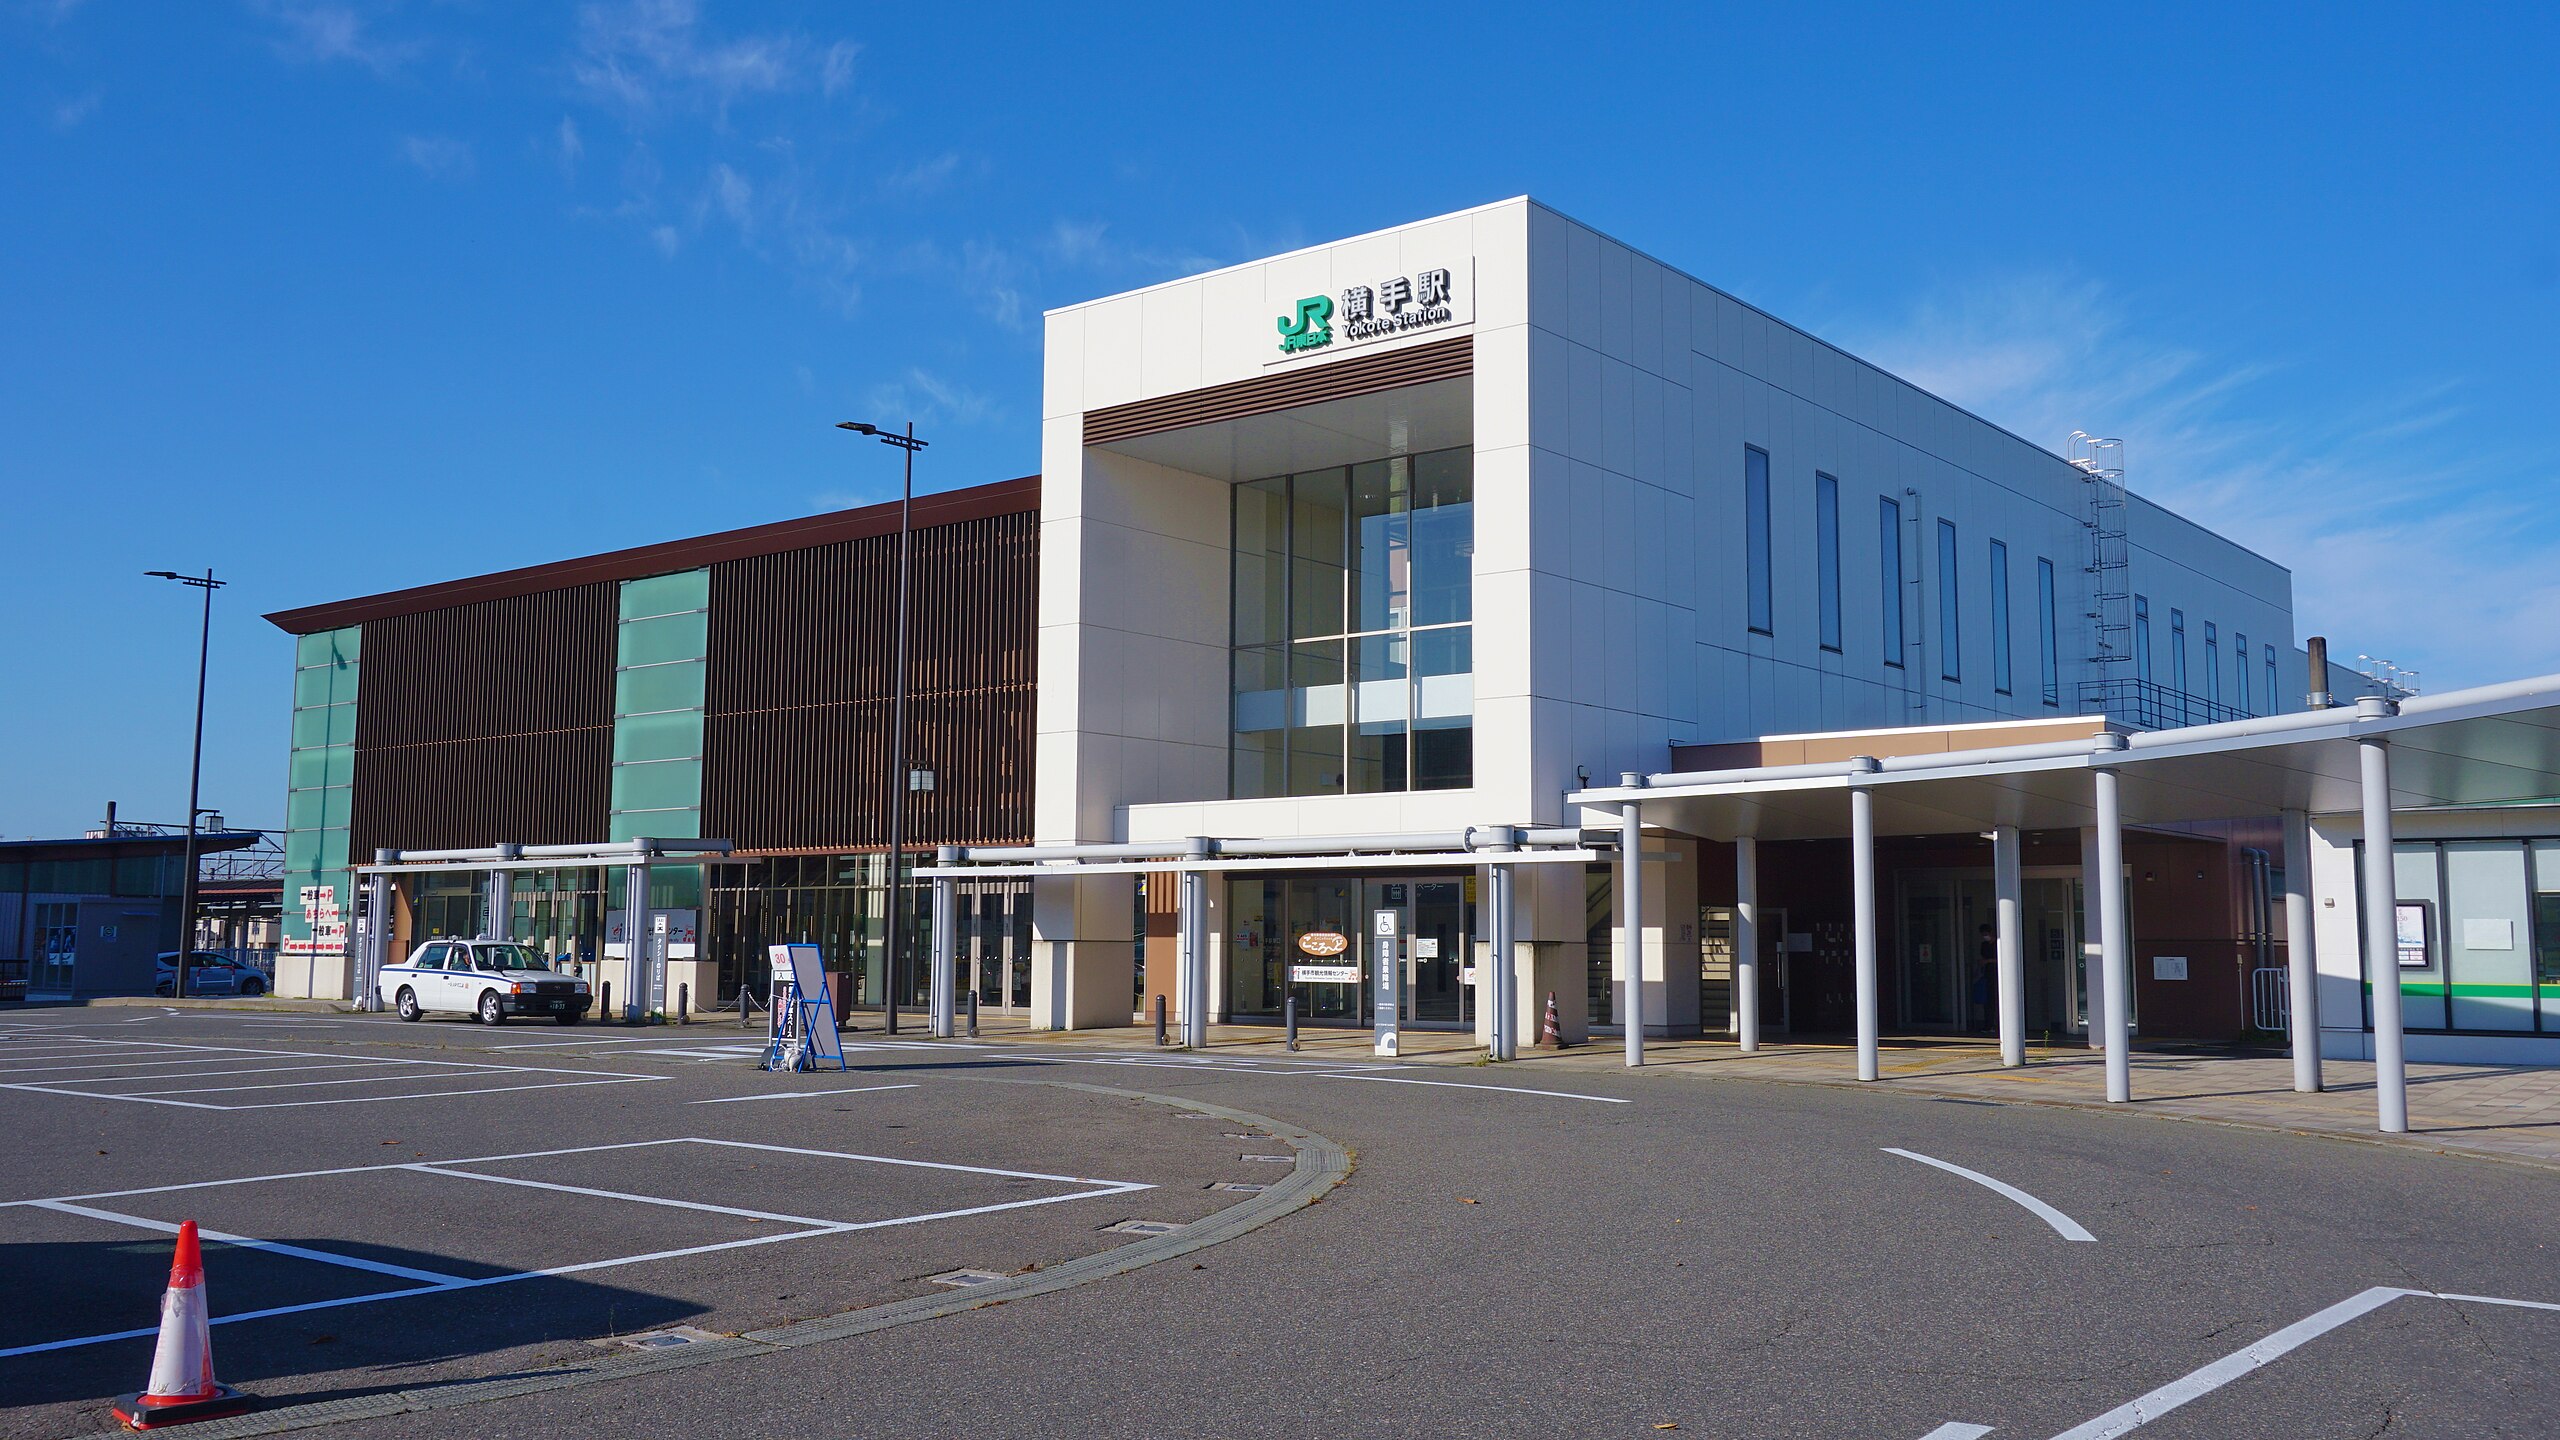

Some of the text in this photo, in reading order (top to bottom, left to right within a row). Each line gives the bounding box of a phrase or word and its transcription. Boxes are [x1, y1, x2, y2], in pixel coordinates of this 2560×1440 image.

[1341, 268, 1449, 321] 横手駅
[1278, 295, 1333, 335] JR
[1342, 307, 1449, 338] Yokote Station
[1279, 330, 1331, 351] JR東日本
[301, 889, 333, 901] 一般車 P
[306, 908, 332, 919] あちらへ
[312, 925, 345, 937] 一般車 P
[284, 938, 290, 950] P
[656, 937, 664, 981] タクシーのりば
